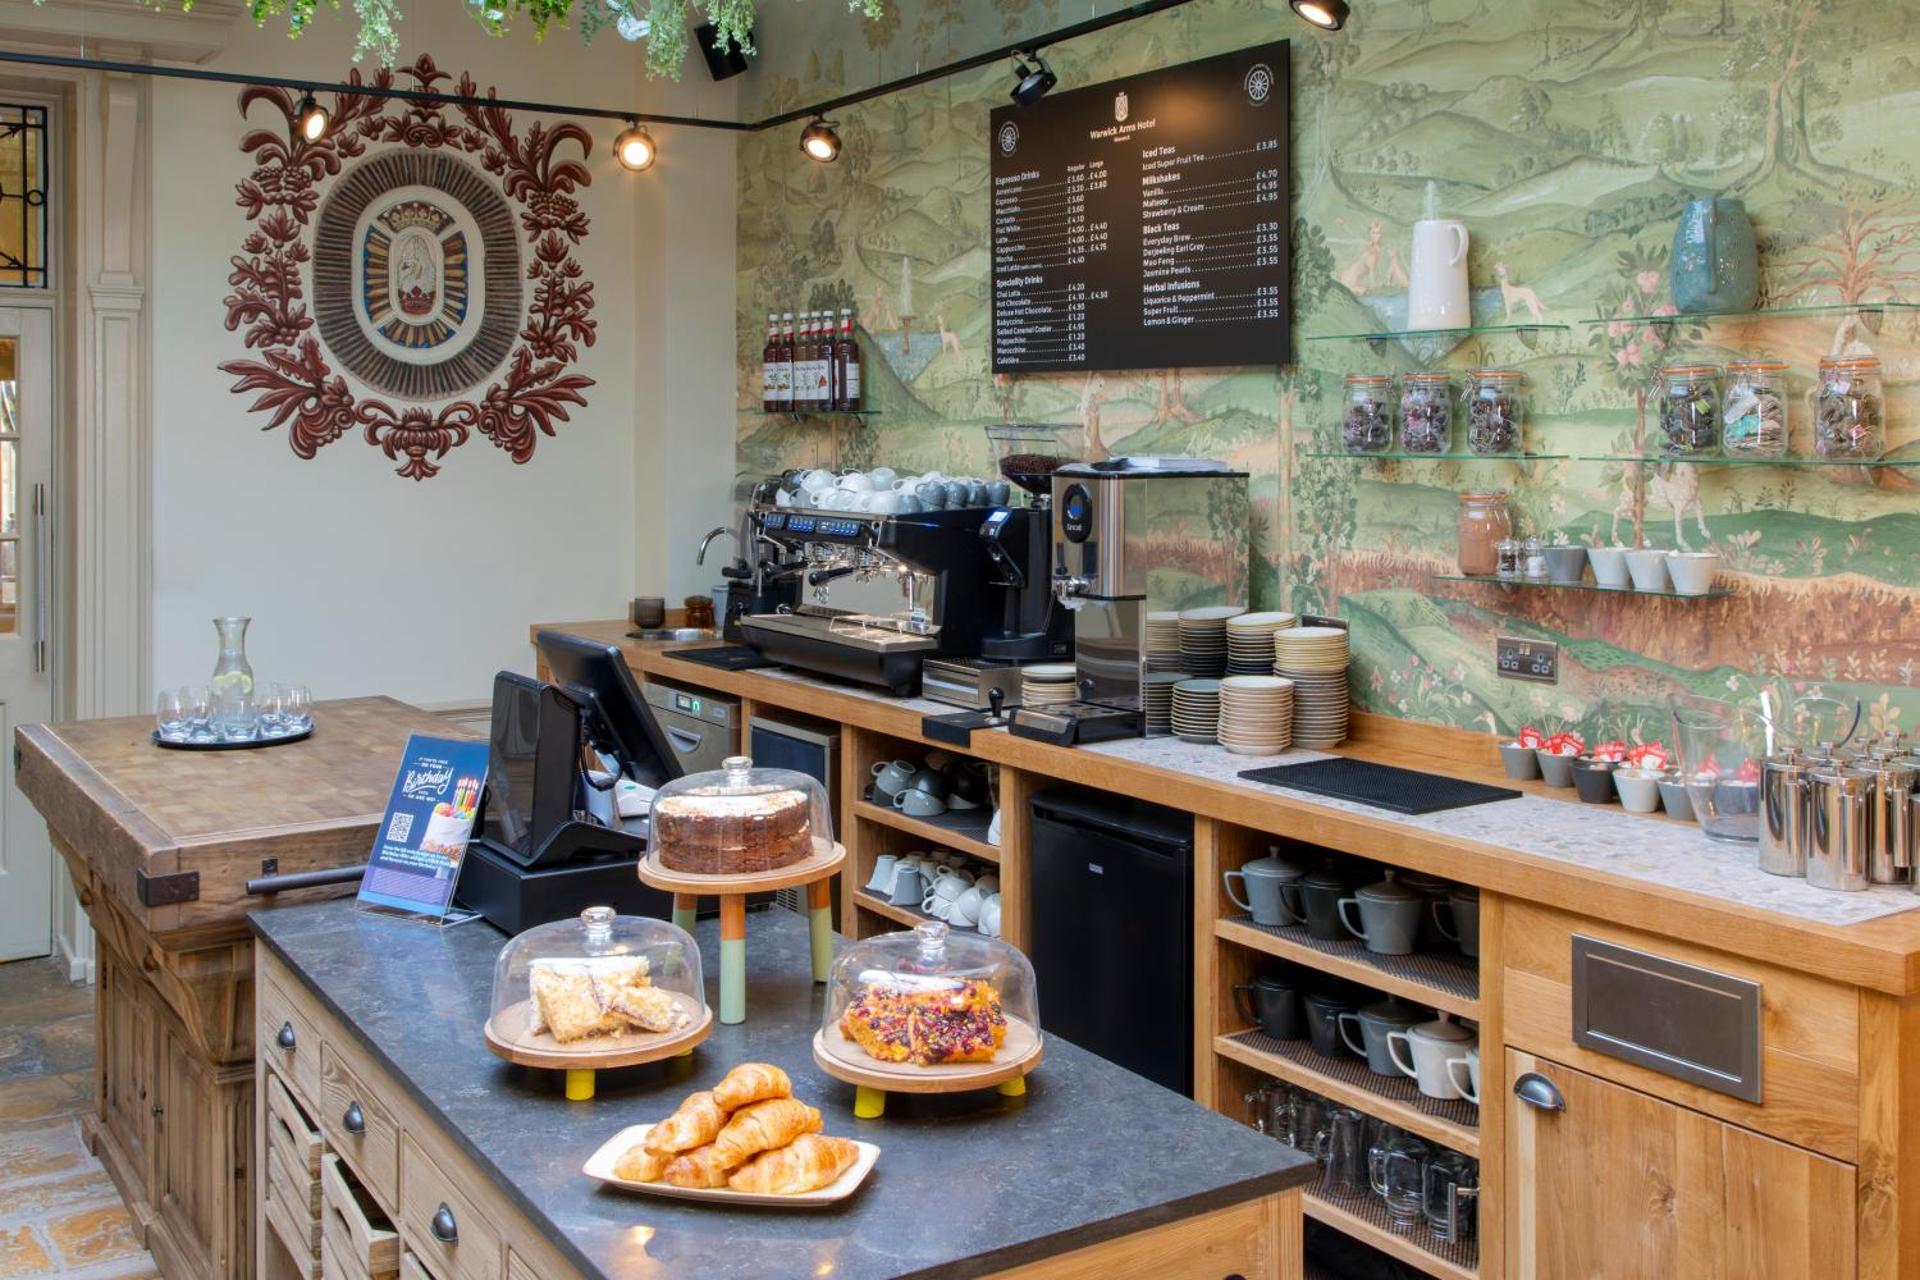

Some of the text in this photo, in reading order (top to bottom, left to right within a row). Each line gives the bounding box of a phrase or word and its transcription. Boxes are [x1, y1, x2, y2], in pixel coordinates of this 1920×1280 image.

[1090, 118, 1156, 139] Warwick Arms Hotel
[1142, 146, 1176, 159] Iced Teas
[1142, 162, 1156, 171] Iced
[1157, 160, 1175, 169] Super
[1176, 156, 1192, 165] Fruit
[996, 171, 1040, 186] Espresso Drinks
[1142, 172, 1180, 185] Milkshakes
[1142, 188, 1164, 198] Vanilla
[1142, 207, 1177, 219] Strawberry
[1183, 204, 1205, 213] Cream
[1143, 222, 1180, 234] Black Teas
[1143, 236, 1173, 246] Everyday
[1143, 234, 1278, 257] Darjeeling Earl Grey £3.55
[1158, 257, 1175, 266] Feng
[1256, 245, 1278, 255] £3.55
[1143, 257, 1278, 278] Jasmine Pearls £3.55
[1025, 275, 1043, 285] Drinks
[1143, 280, 1200, 292] Herbal Infusions
[1143, 295, 1172, 305] Liquorice
[1177, 292, 1215, 303] Peppermint
[1257, 286, 1279, 296] £3.55
[1144, 298, 1279, 316] Super Fruit £3.55
[1172, 316, 1195, 325] Ginger
[1257, 309, 1279, 319] £3.55
[402, 768, 454, 795] Birthday
